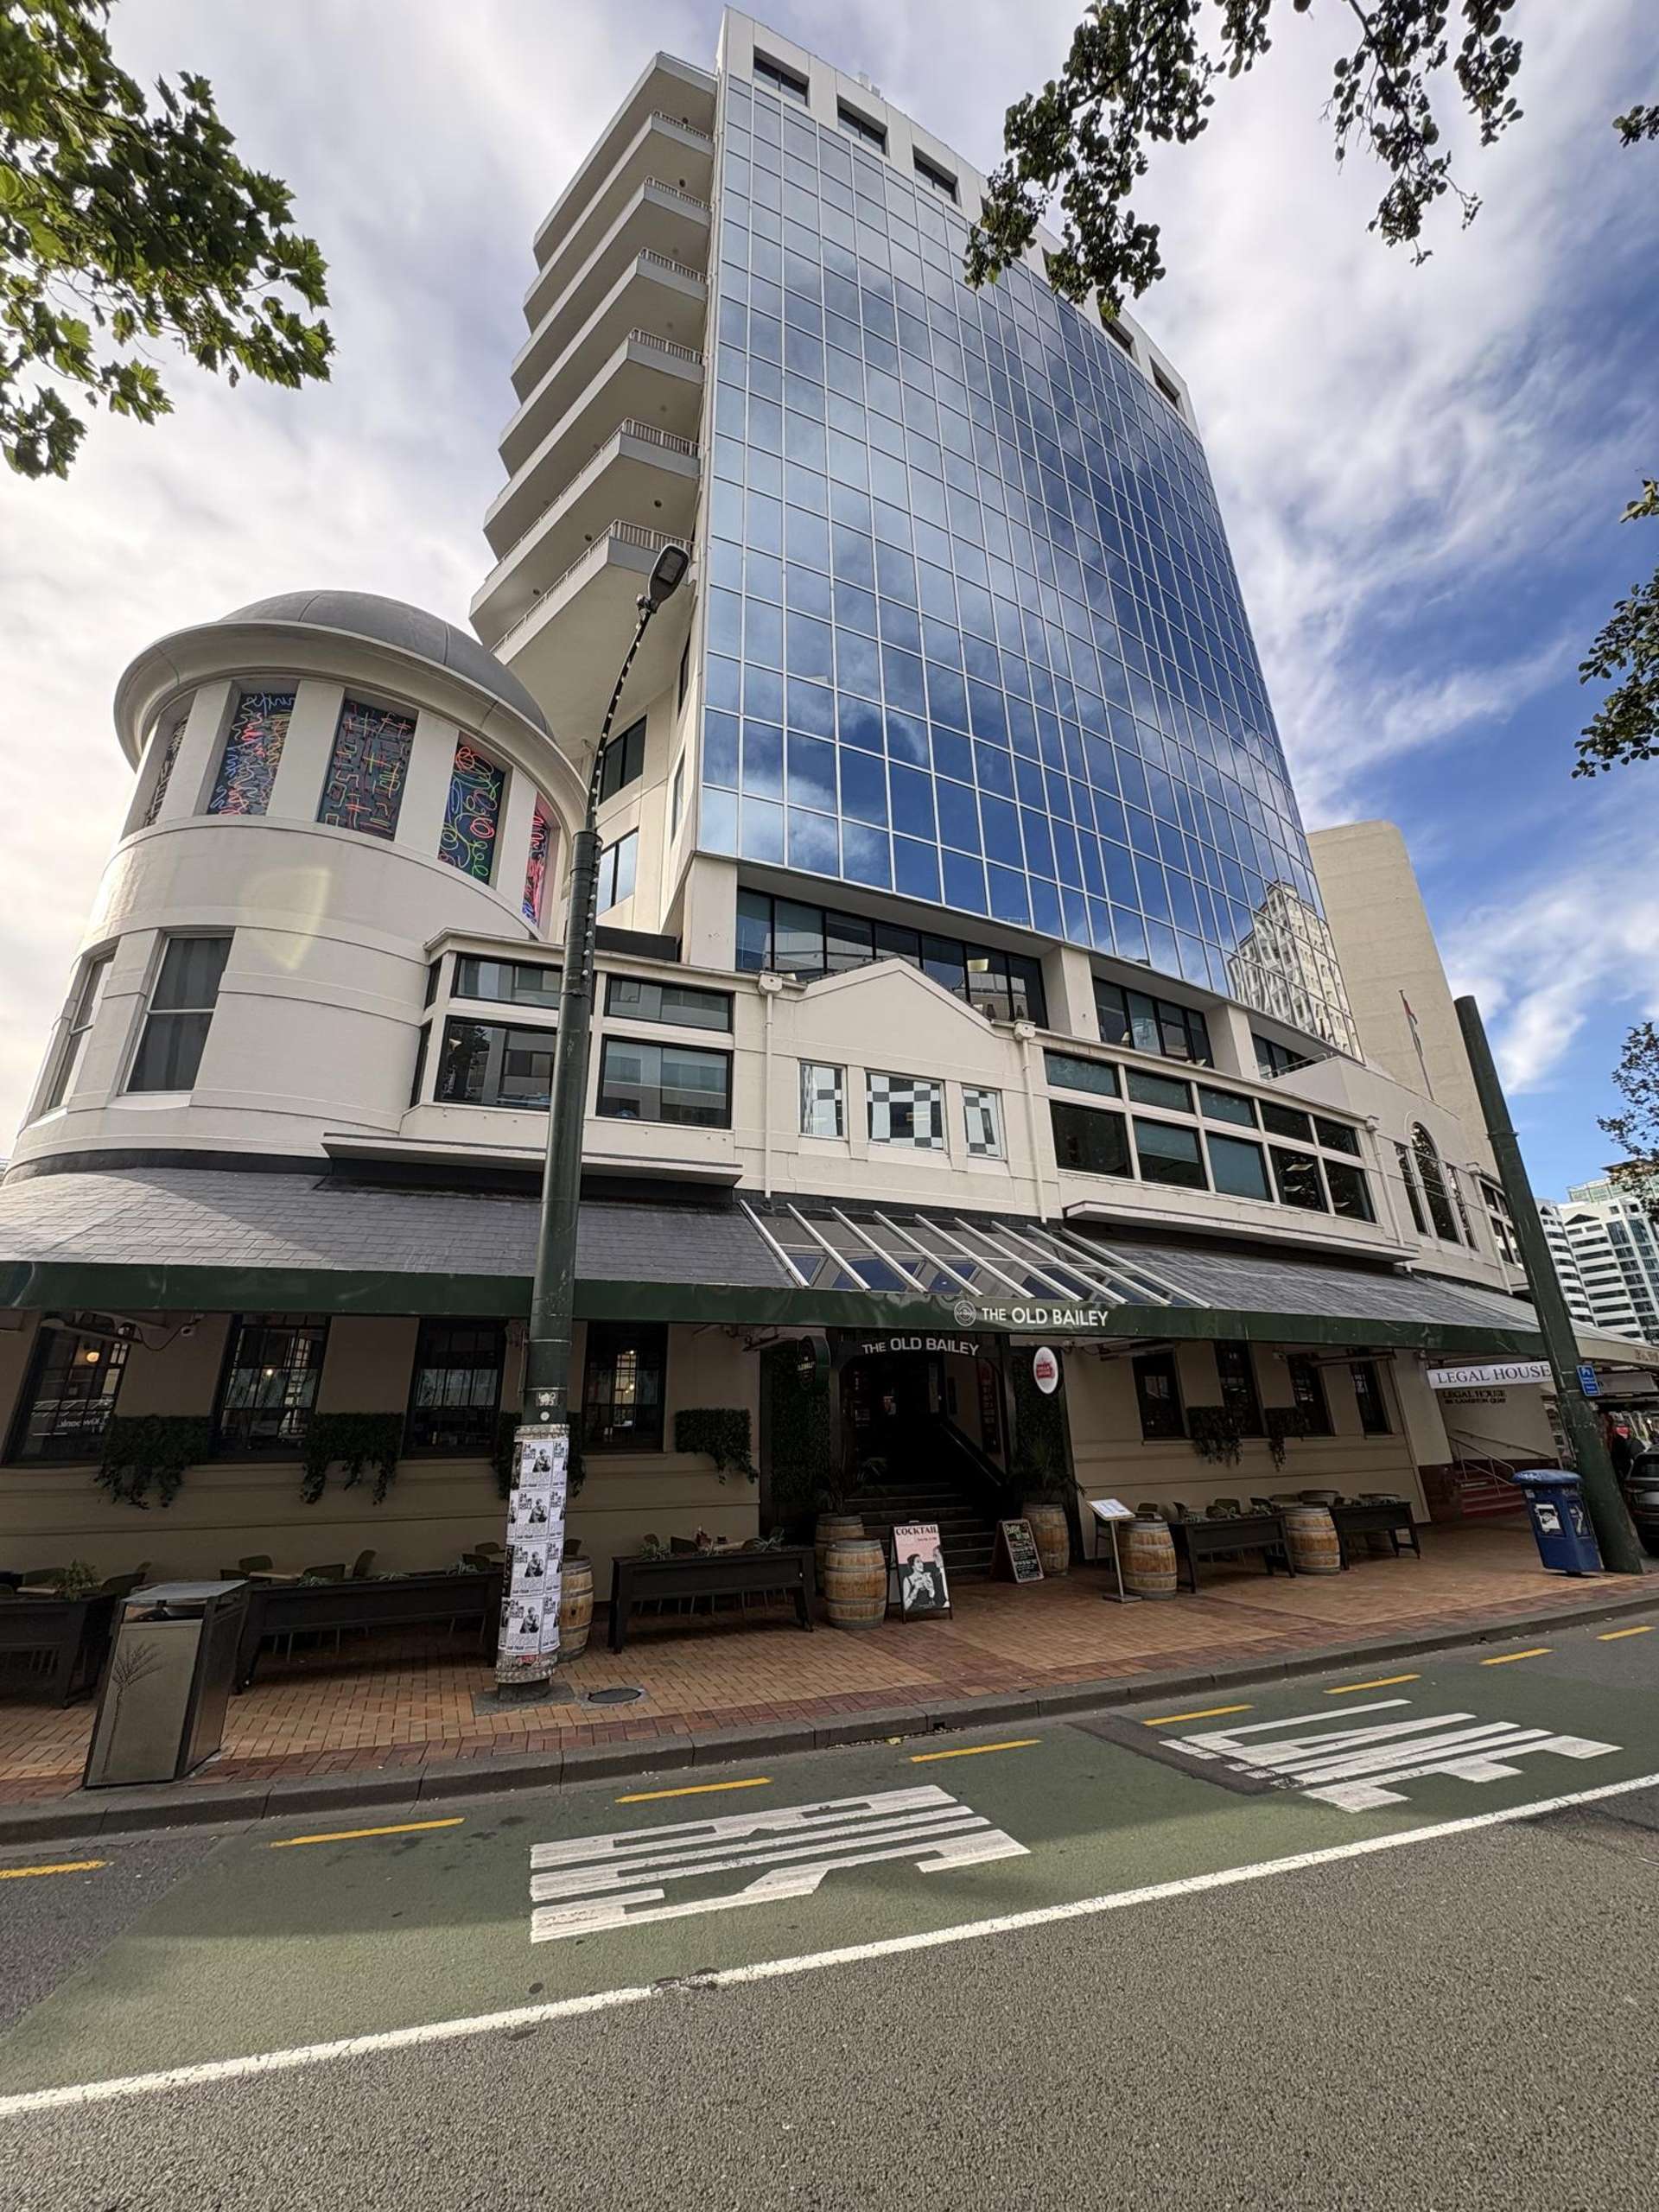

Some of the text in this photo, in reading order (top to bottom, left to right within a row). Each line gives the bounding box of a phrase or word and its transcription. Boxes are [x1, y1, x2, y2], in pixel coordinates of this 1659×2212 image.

[982, 1307, 1007, 1321] THE
[1012, 1306, 1048, 1324] OLD
[1052, 1308, 1109, 1326] BAILEY
[861, 1337, 980, 1356] THE OLD BAILEY
[1436, 1364, 1552, 1384] LEGAL HOUSE
[1159, 1699, 1624, 1813] LANE
[530, 1784, 1030, 1943] BUS
